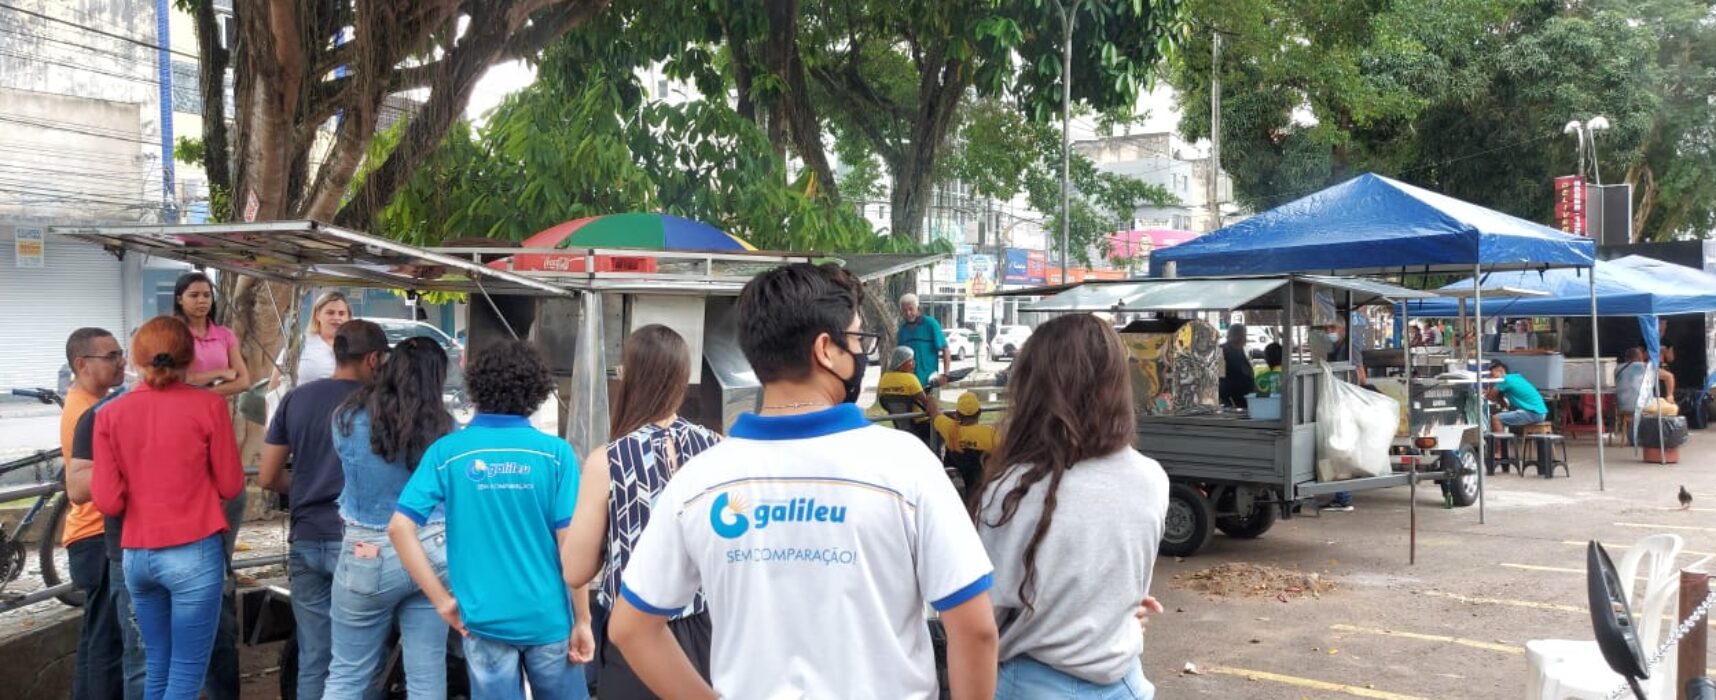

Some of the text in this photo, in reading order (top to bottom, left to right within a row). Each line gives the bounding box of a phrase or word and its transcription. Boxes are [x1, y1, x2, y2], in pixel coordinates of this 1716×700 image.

[487, 462, 531, 478] galileu
[754, 497, 847, 529] galileu
[726, 549, 751, 563] SEM
